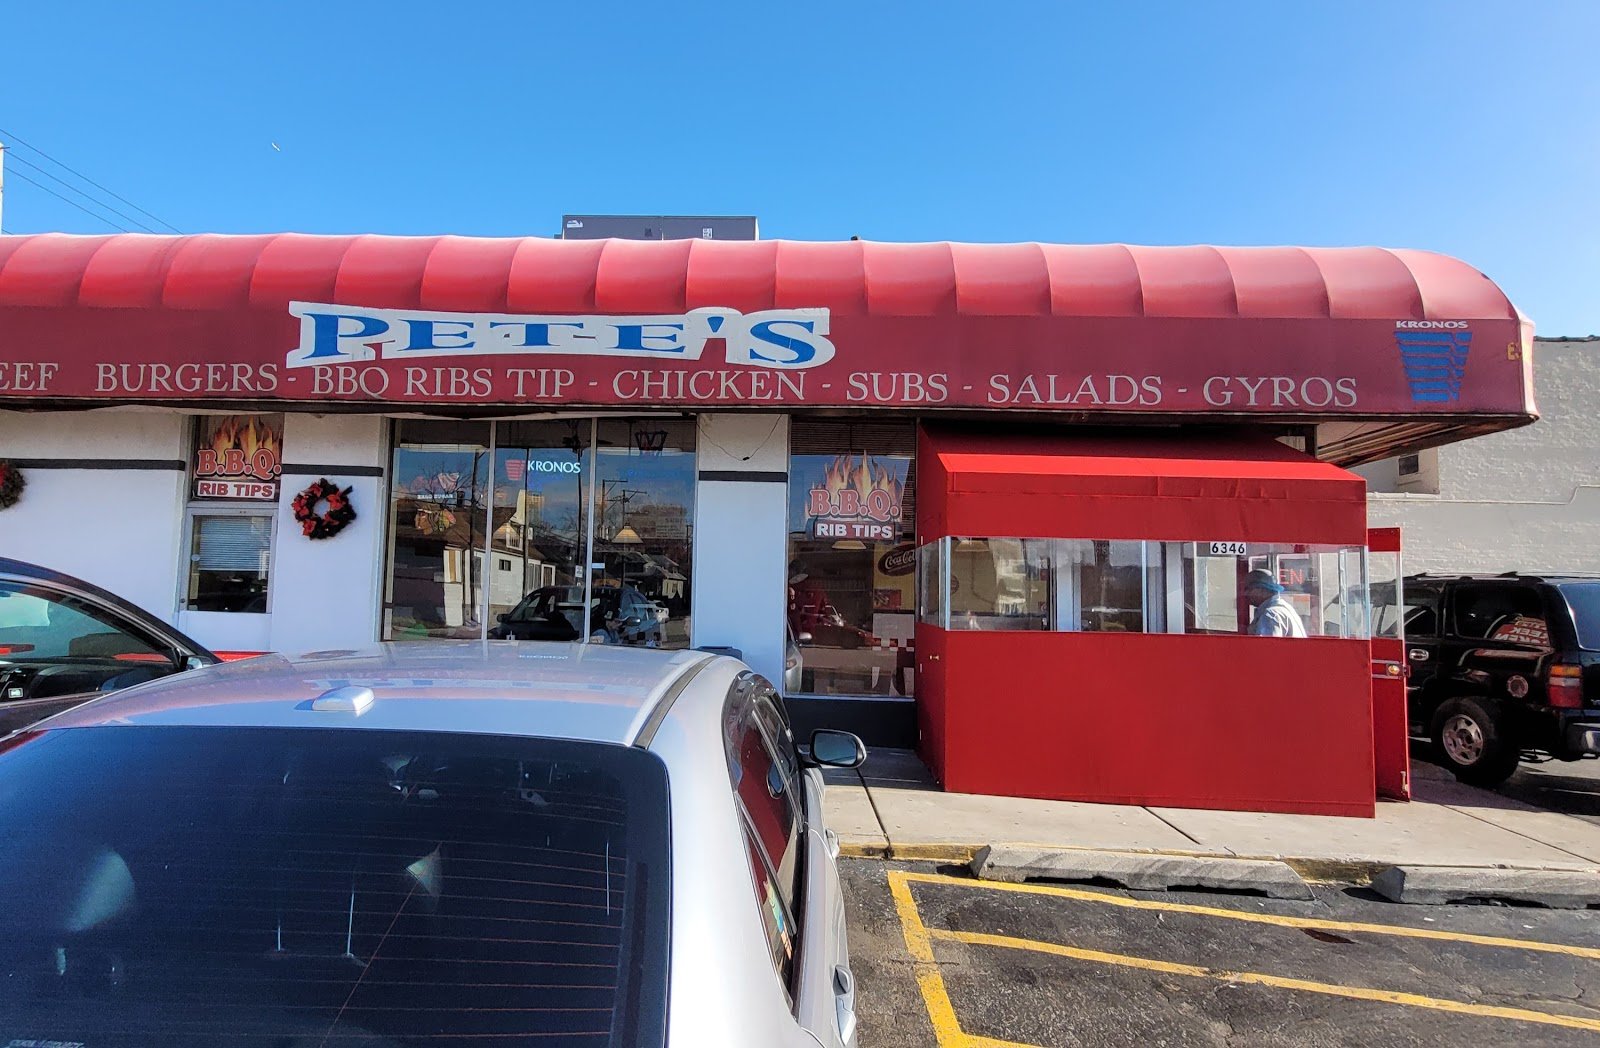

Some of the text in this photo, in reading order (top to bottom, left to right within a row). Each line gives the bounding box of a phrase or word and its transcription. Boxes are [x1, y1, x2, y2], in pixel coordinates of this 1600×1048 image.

[1395, 320, 1469, 329] KRONOS
[299, 312, 819, 367] PETE'S
[94, 362, 279, 393] BURGERS
[311, 364, 389, 400] BBQ
[403, 366, 492, 397] RIBS
[506, 368, 575, 398] TIP
[612, 369, 808, 401] CHICKEN
[845, 371, 949, 403] SUBS
[986, 374, 1163, 406] SALADS
[1202, 376, 1358, 408] GYROS
[196, 448, 282, 481] B.B.Q.
[527, 459, 582, 474] KRONOS
[199, 482, 274, 498] RIB TIPS
[809, 489, 900, 522] B.B.Q.
[816, 522, 894, 539] RIB TIPS
[1211, 543, 1246, 554] 6346
[1279, 568, 1304, 585] EN
